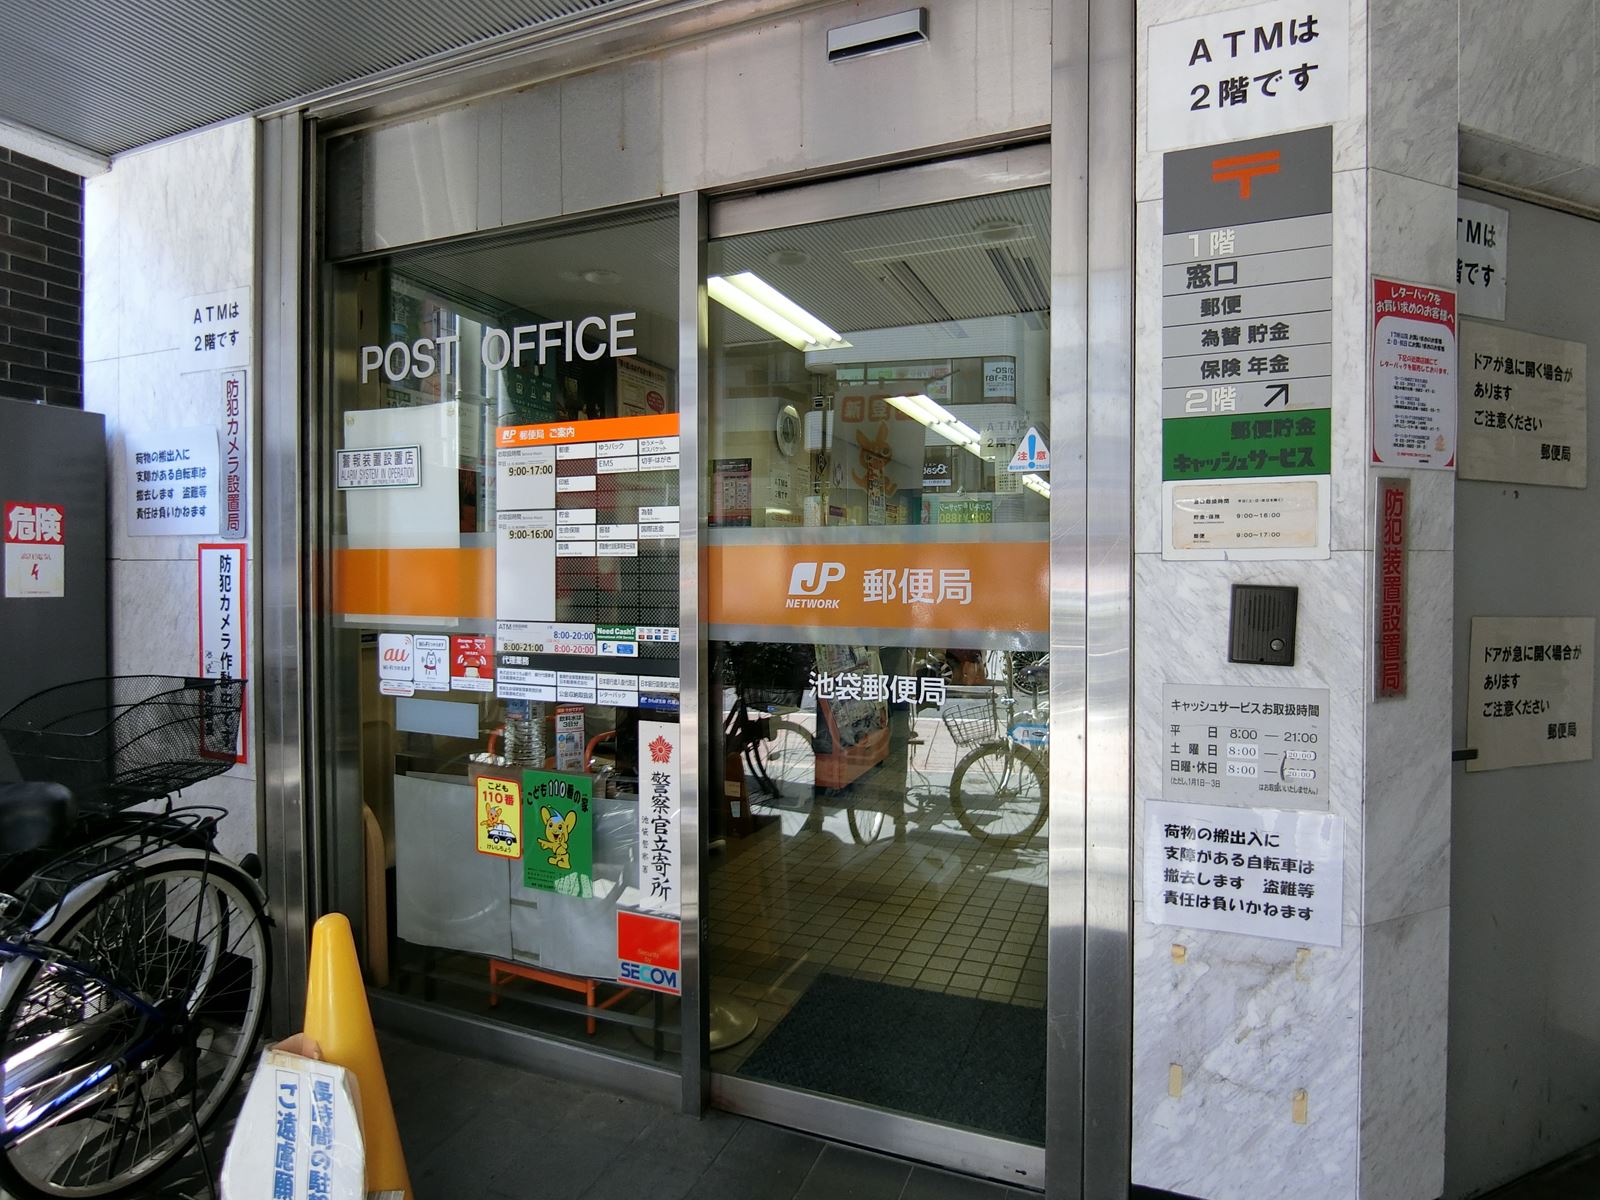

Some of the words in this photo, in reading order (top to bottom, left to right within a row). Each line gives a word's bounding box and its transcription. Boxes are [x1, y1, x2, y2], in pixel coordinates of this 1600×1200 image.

[1189, 62, 1319, 112] 2階です
[1188, 229, 1236, 258] 1階
[1185, 261, 1238, 290] 窓口
[193, 301, 240, 325] ATMは
[1200, 295, 1242, 318] 郵便
[193, 329, 240, 352] 2階です
[1200, 325, 1242, 348] 為替
[1247, 322, 1290, 344] 貯金
[360, 335, 460, 385] POST
[481, 312, 638, 371] OFFICE
[1200, 358, 1242, 380] 保険
[1247, 354, 1290, 376] 年金
[1474, 352, 1573, 383] ドアが急に開く場合が
[1184, 386, 1237, 413] 2階
[1473, 381, 1512, 401] あります
[549, 427, 576, 439] ご案内
[1229, 416, 1317, 441] 郵便貯金
[1473, 409, 1543, 433] ご注意ください
[225, 379, 240, 533] 防犯カメラ設置局
[598, 459, 614, 468] EMS
[1172, 447, 1317, 473] キャッシュサービス
[1540, 443, 1571, 463] 郵便局
[508, 464, 553, 476] 9:00-17:00
[8, 505, 63, 542] 危険
[509, 529, 554, 541] 9:00-16:00
[787, 562, 846, 596] JP
[862, 567, 972, 606] 郵便局
[1382, 488, 1404, 691] 防犯装置設置局
[785, 597, 840, 610] NETWORK
[553, 631, 594, 641] 8:00-20:00
[597, 627, 614, 635] Need
[614, 628, 635, 636] Cash?
[384, 647, 410, 662] au
[503, 642, 544, 652] 8:00-21:00
[554, 644, 595, 654] 8:00-20:00
[1484, 644, 1583, 664] ドアが急に開く場合が
[808, 671, 948, 707] 池袋郵便局
[1483, 673, 1521, 691] あります
[1482, 699, 1551, 718] ご注意ください
[1229, 728, 1258, 741] 8:00
[1283, 732, 1319, 744] 21:00
[1547, 721, 1577, 740] 郵便局
[482, 790, 515, 807] 110番
[487, 781, 509, 793] こども
[650, 771, 672, 902] 警察官立寄所
[1163, 824, 1281, 848] 荷物の搬出入に
[486, 843, 512, 854] けいしちょう
[1163, 846, 1315, 875] 支障がある自転車は
[1163, 867, 1245, 890] 撤去します
[1262, 878, 1315, 900] 盗難等
[1163, 890, 1314, 921] 責任は負いかねます
[621, 961, 677, 988] SECOM
